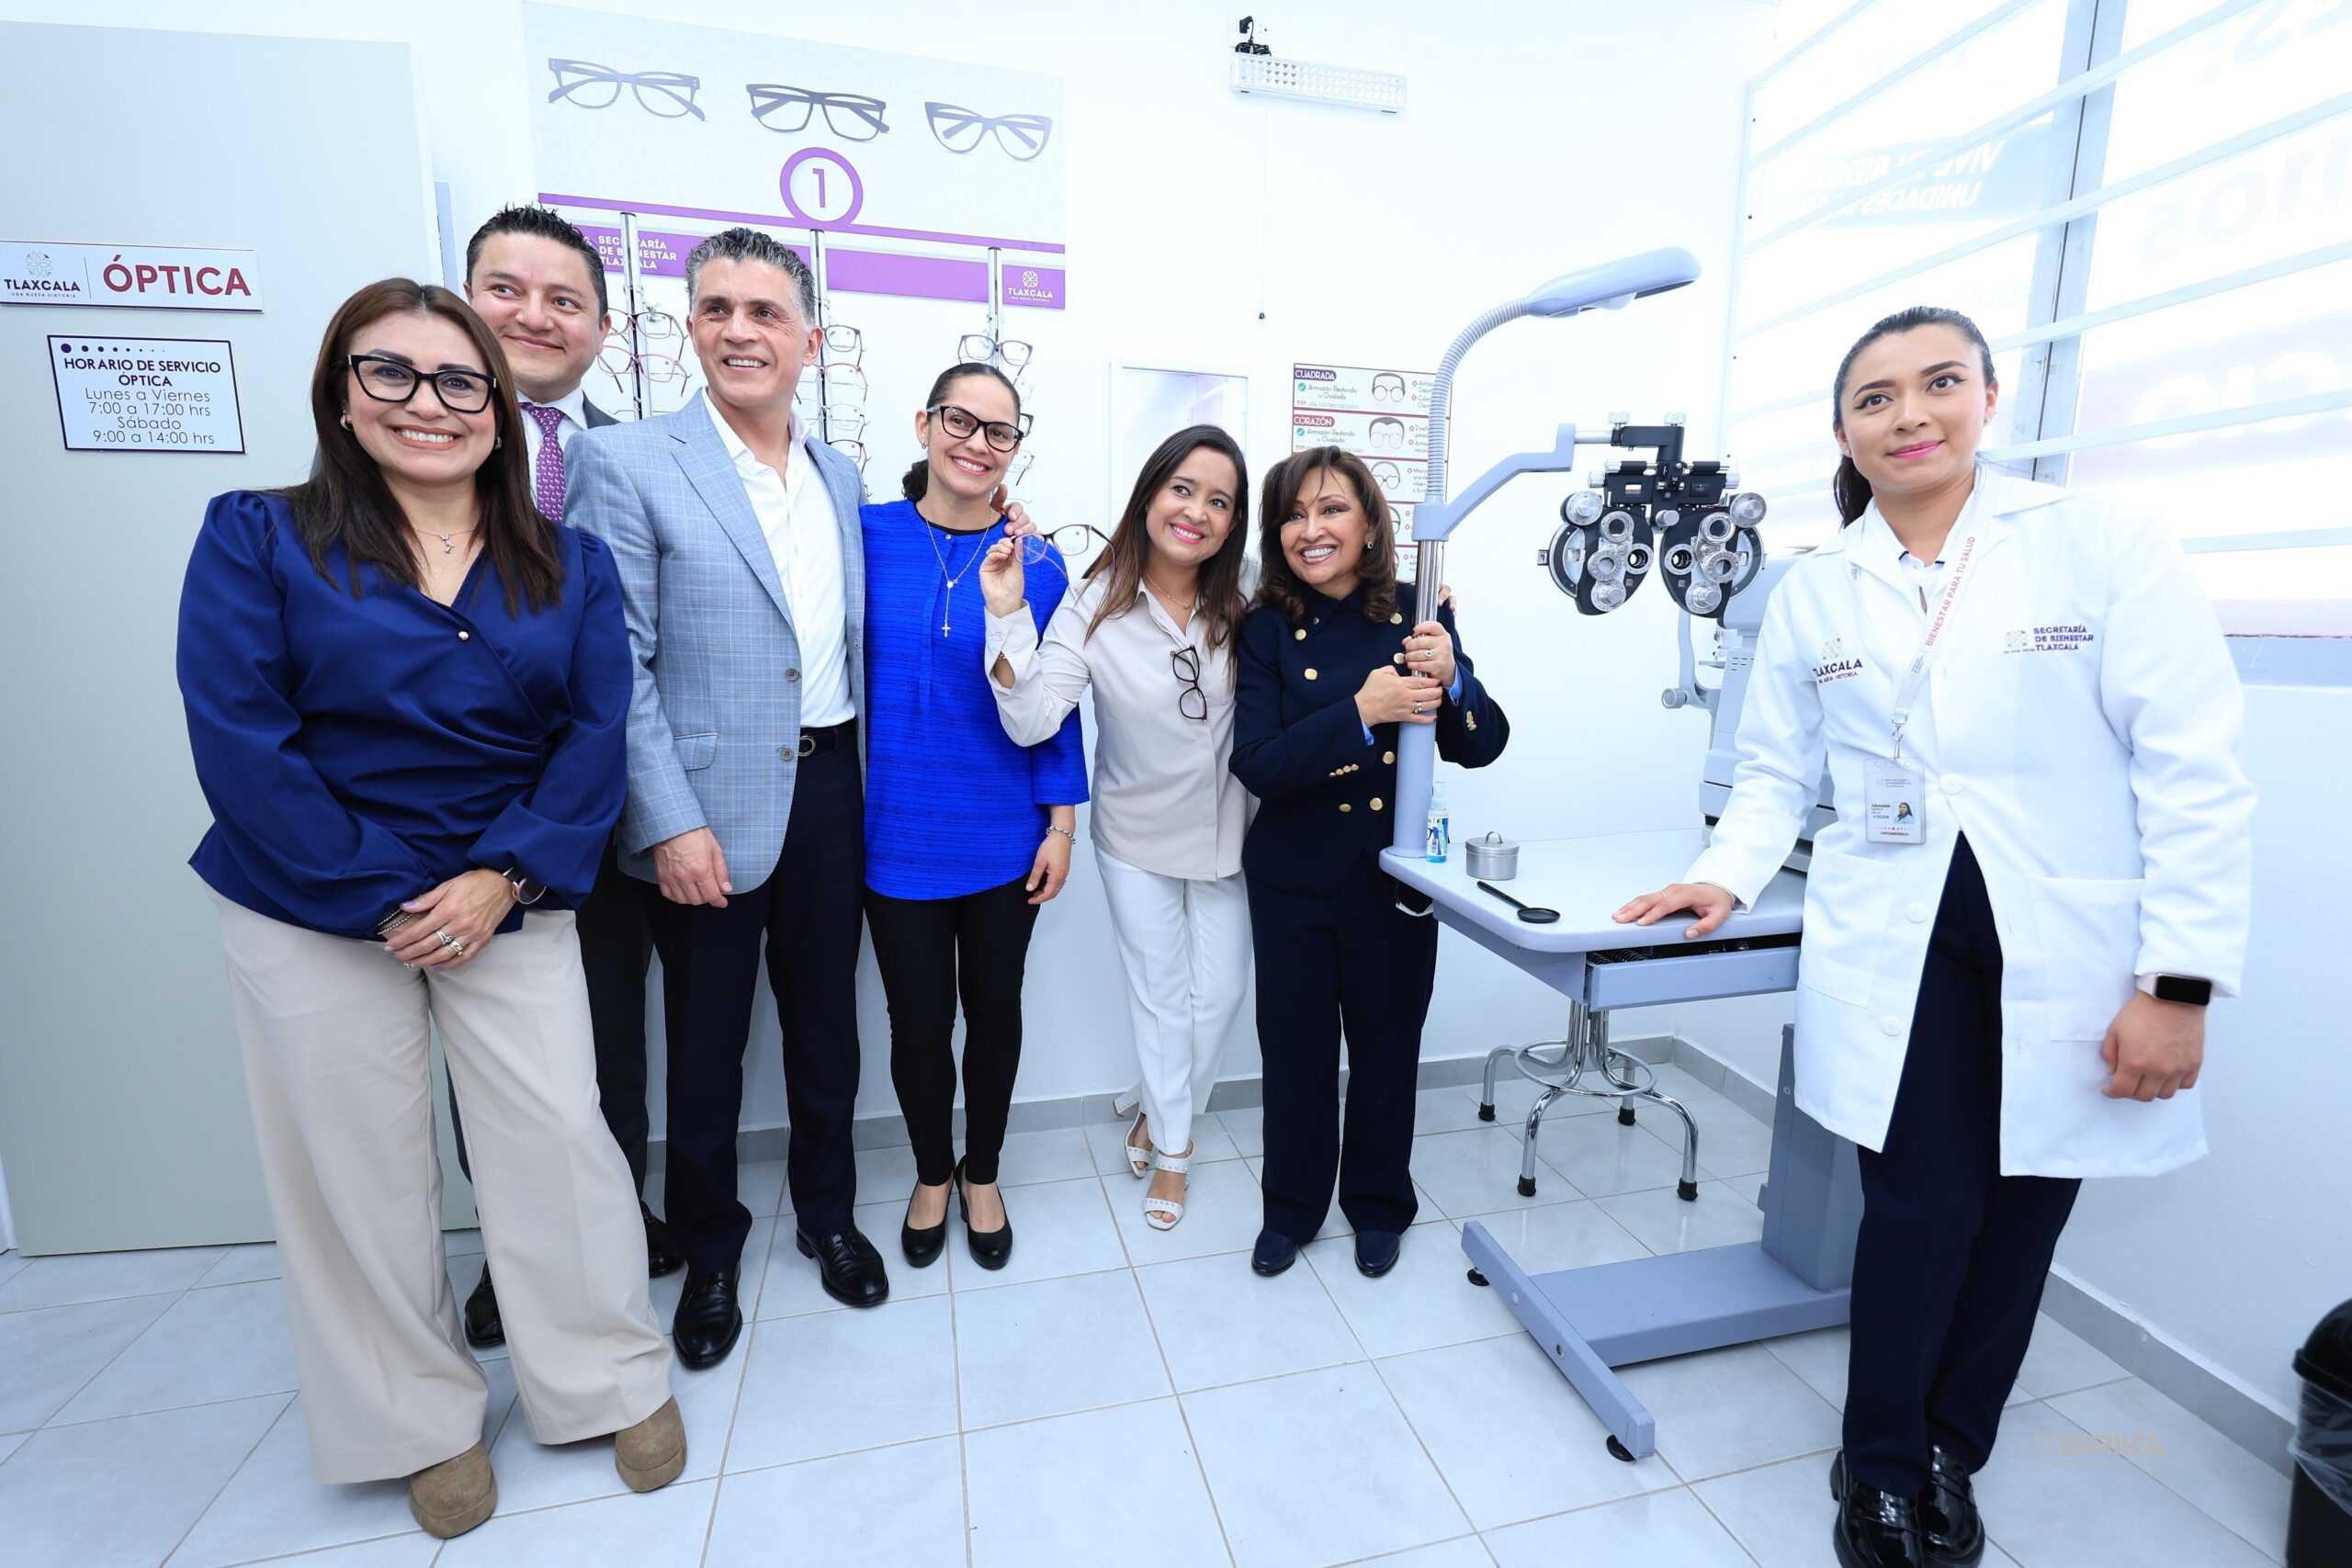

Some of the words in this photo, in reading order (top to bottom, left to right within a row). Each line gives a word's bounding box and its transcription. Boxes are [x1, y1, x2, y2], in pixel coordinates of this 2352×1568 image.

[811, 168, 826, 209] 1
[598, 235, 667, 250] SECARÍA
[599, 246, 614, 255] DE
[103, 254, 252, 296] ÓPTICA
[4, 278, 81, 292] TLAXCALA
[1008, 287, 1053, 299] TLAXCALA
[64, 357, 133, 371] HORARIO
[137, 360, 154, 371] DE
[158, 360, 221, 373] SERVICIO
[119, 371, 173, 387] ÓPTICA
[1295, 369, 1335, 380] CUADRADA
[85, 388, 130, 400] Lunes
[136, 390, 146, 401] a
[152, 389, 210, 402] Viernes
[88, 401, 121, 414] 7:00
[127, 404, 137, 414] a
[144, 403, 184, 416] 17:00
[189, 404, 211, 417] hrs
[118, 415, 181, 430] Sábado
[1294, 416, 1332, 426] CORAZÓN
[93, 430, 126, 443] 9:00
[130, 433, 141, 443] a
[148, 431, 188, 444] 14:00
[193, 433, 215, 445] hrs
[1961, 536, 1976, 563] SALUD
[1956, 562, 1967, 574] TU
[1947, 575, 1962, 599] PARA
[1925, 599, 1952, 648] BIENESTAR
[2033, 625, 2087, 635] SECRETARÍA
[2035, 635, 2048, 643] DE
[2050, 634, 2095, 642] BIENESTAR
[2036, 643, 2079, 652] TLAXCALA
